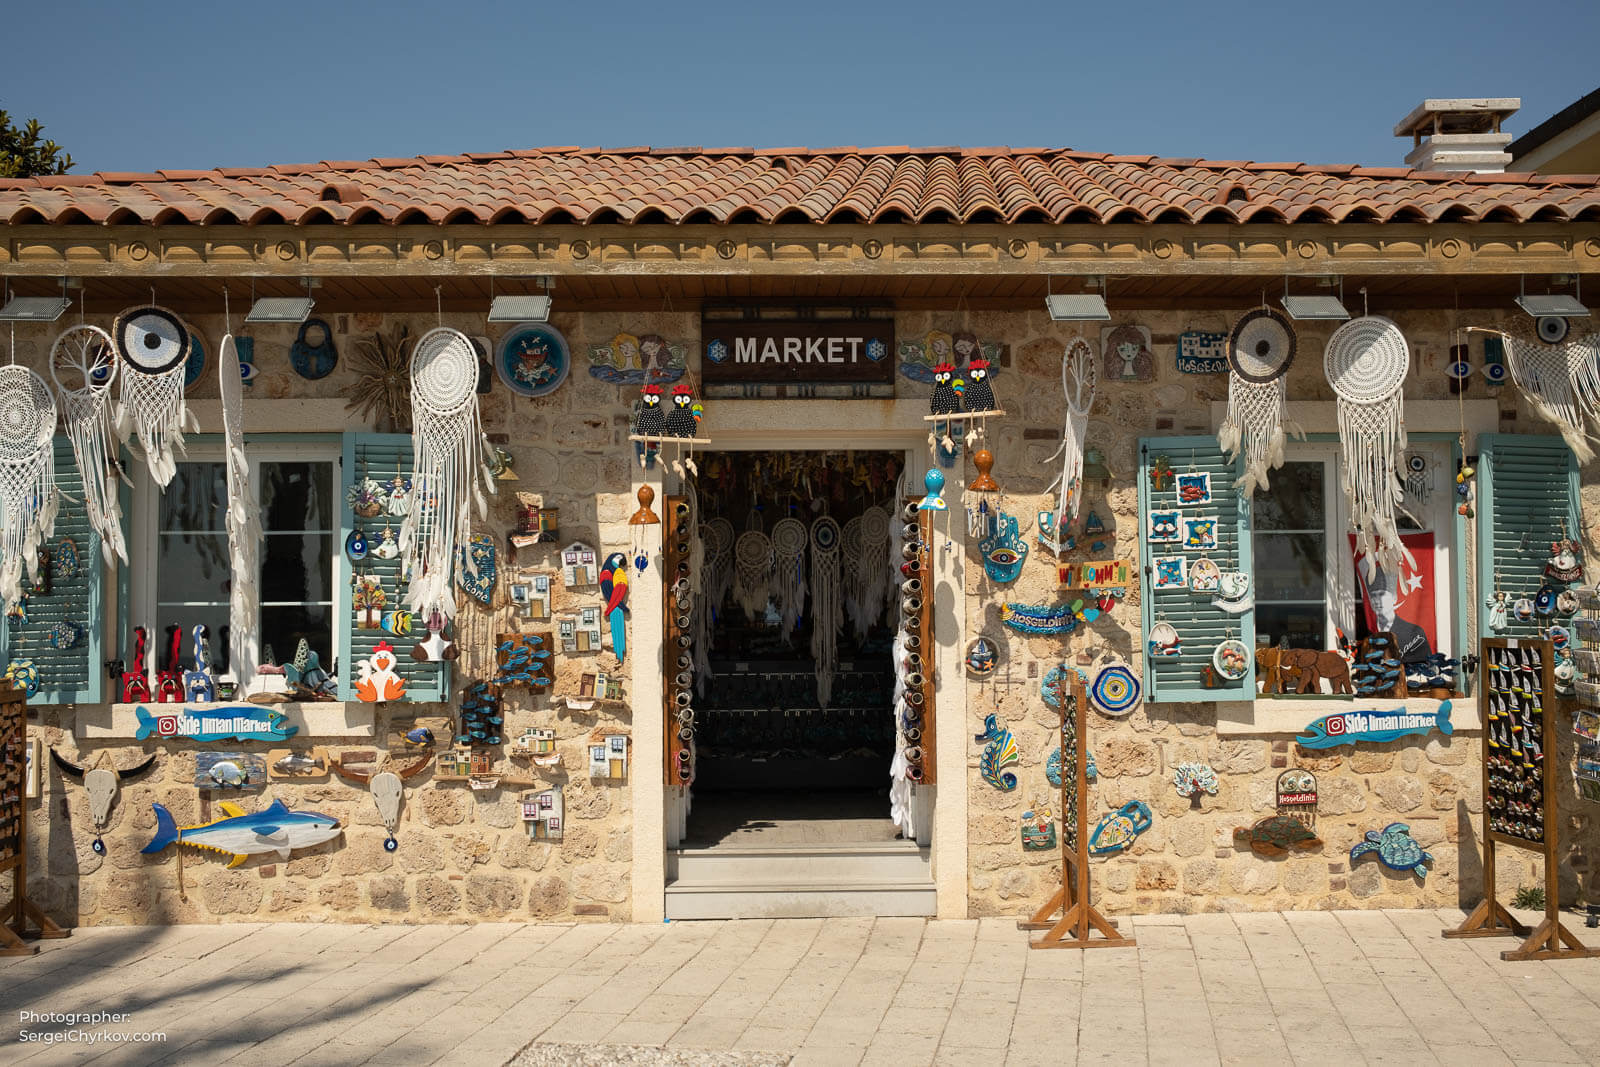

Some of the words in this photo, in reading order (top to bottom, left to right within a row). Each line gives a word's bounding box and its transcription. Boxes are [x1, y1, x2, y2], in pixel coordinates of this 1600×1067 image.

[735, 337, 863, 363] MARKET
[177, 715, 200, 736] Side
[1345, 714, 1368, 734] Side
[1369, 714, 1399, 732] liman
[1400, 715, 1437, 730] market
